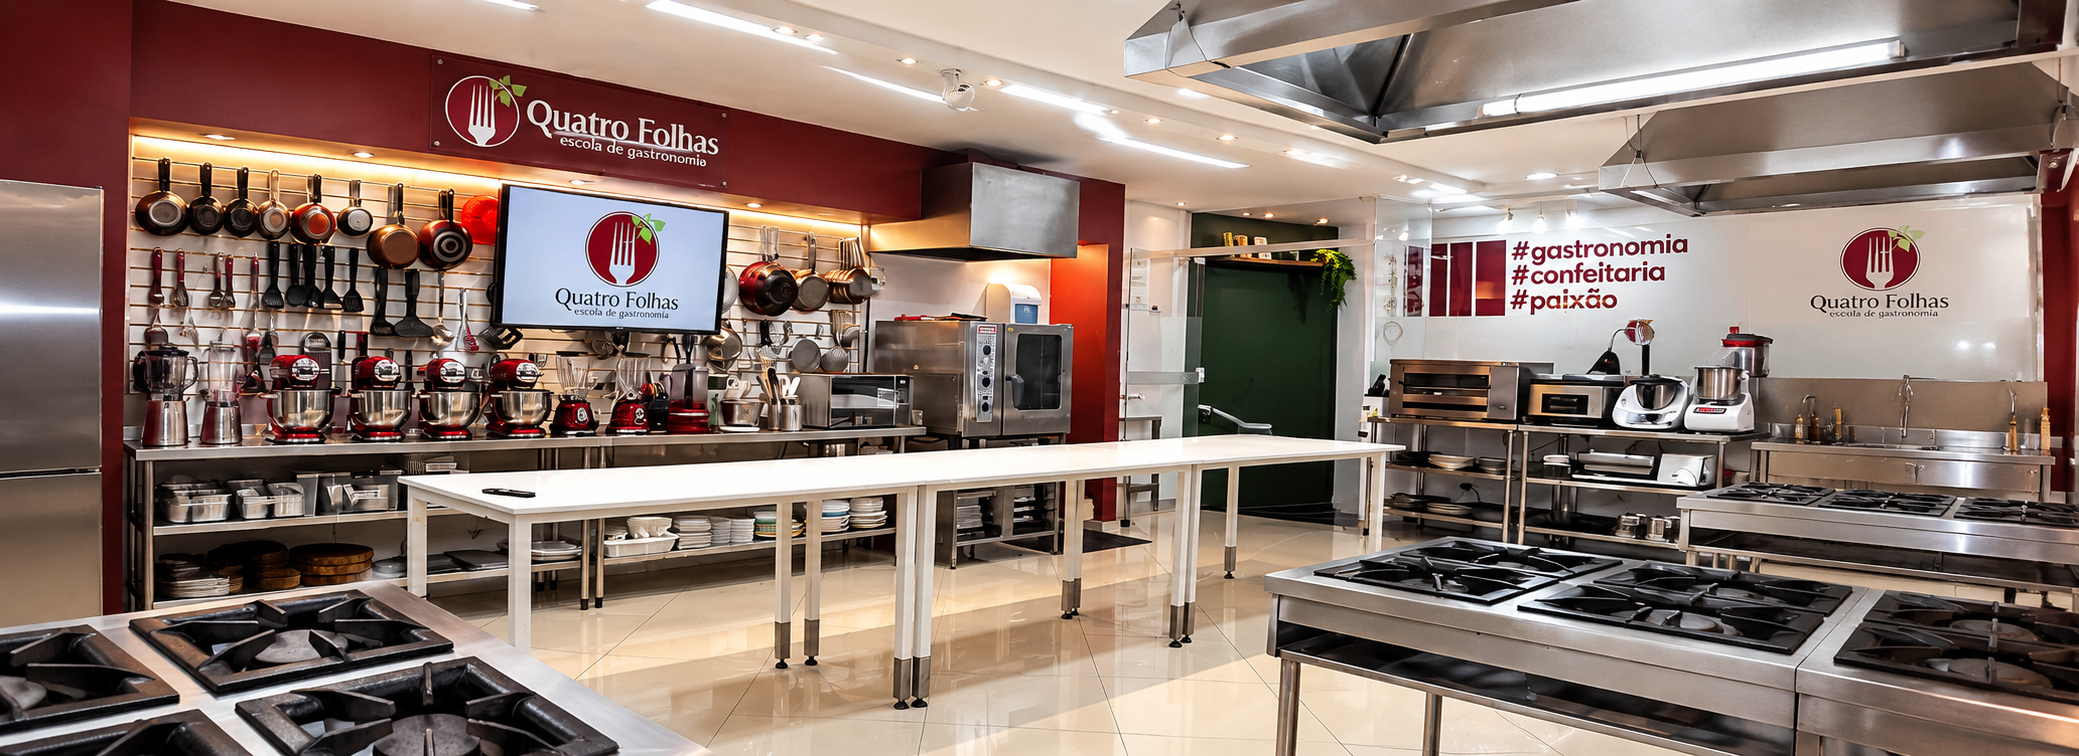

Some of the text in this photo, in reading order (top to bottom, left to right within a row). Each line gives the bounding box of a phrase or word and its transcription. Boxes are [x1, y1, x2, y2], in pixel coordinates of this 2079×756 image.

[527, 100, 719, 155] Quatro Folhas
[560, 136, 602, 152] escola
[607, 140, 624, 155] de
[1511, 234, 1689, 266] #gastronomia
[1511, 261, 1666, 285] #confeitaria
[555, 287, 679, 311] Quatro Folhas
[1510, 288, 1618, 315] #paixão
[1810, 293, 1949, 313] Quatro Folhas
[574, 308, 669, 320] escola de gastronomia
[1829, 309, 1939, 319] escola de gastronomia
